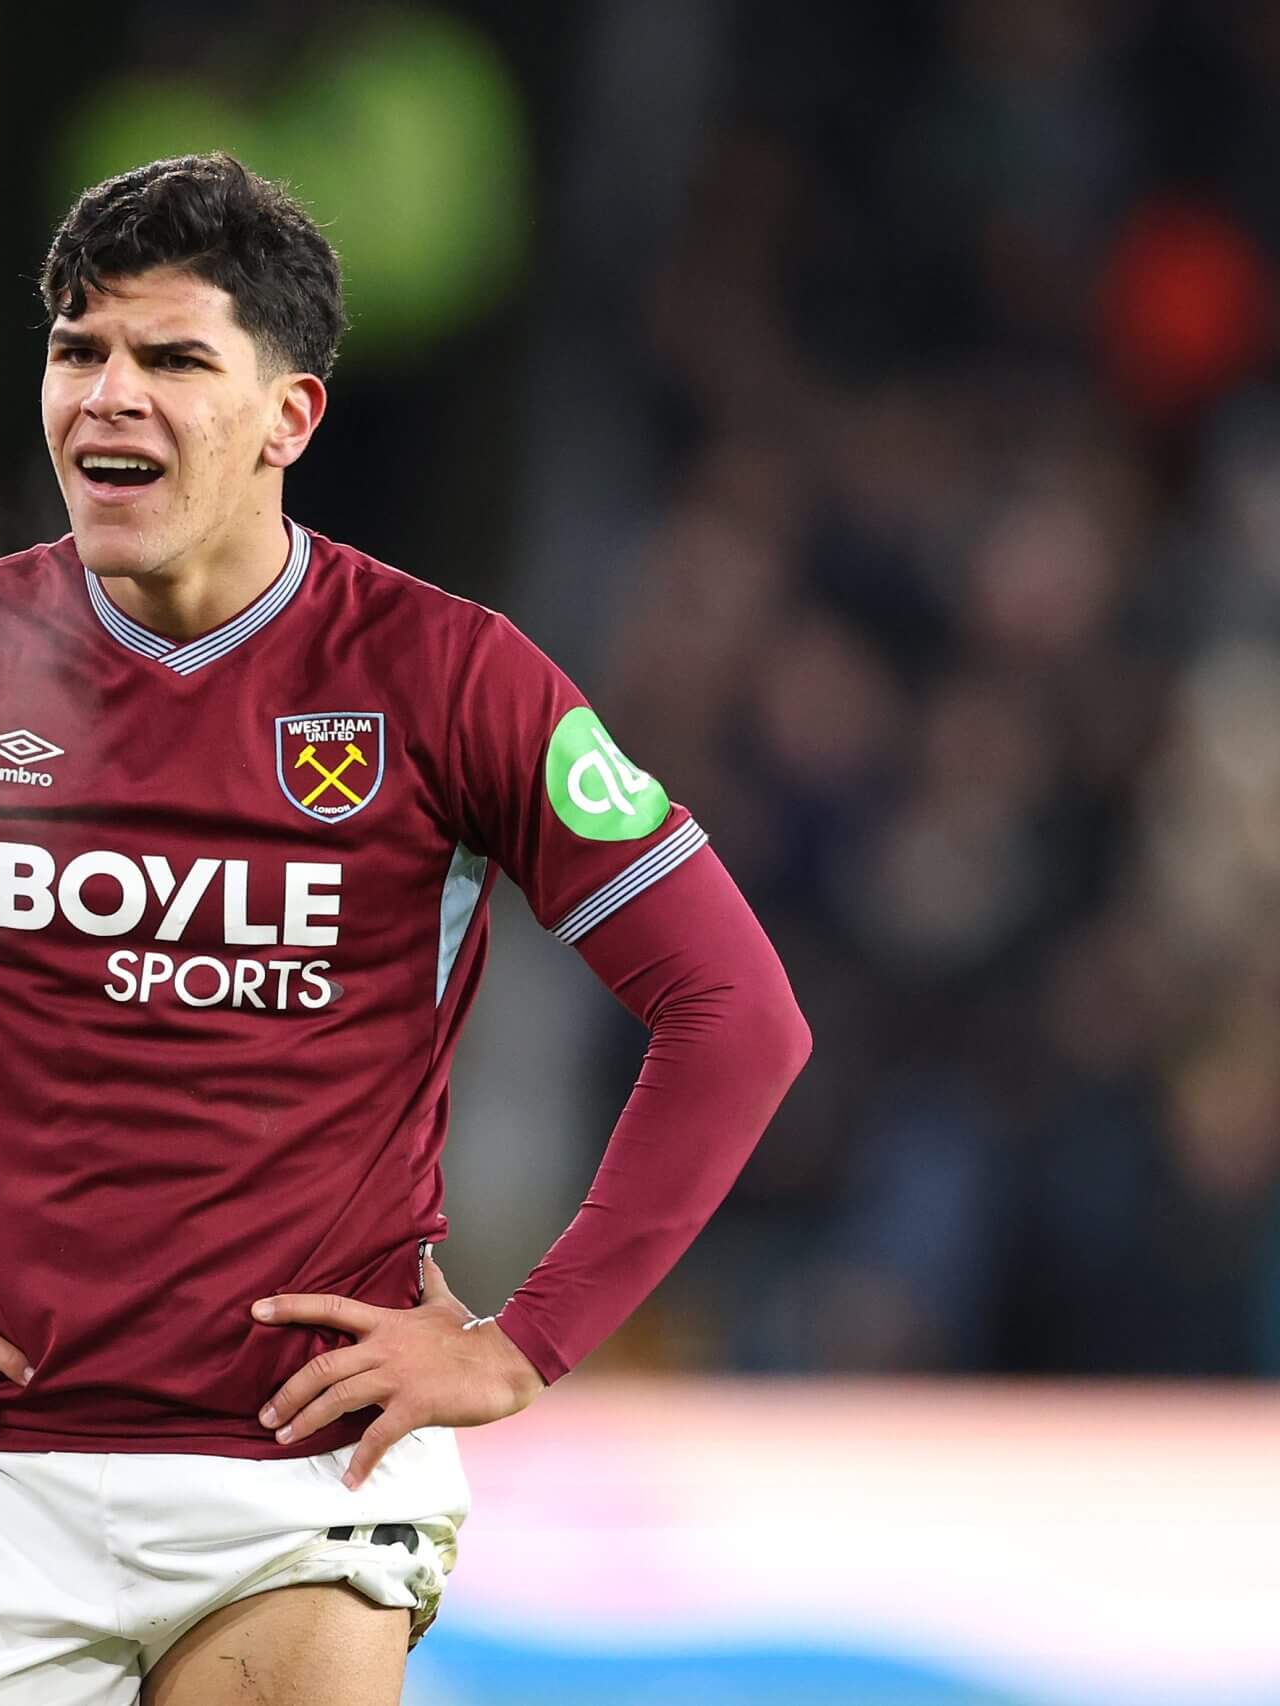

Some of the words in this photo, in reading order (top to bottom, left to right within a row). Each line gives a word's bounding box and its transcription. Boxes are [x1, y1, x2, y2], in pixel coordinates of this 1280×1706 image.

[287, 719, 331, 735] WEST
[333, 718, 372, 733] HAM
[306, 731, 354, 742] UNITED
[313, 804, 351, 814] LONDON
[104, 950, 332, 1010] SPORTS
